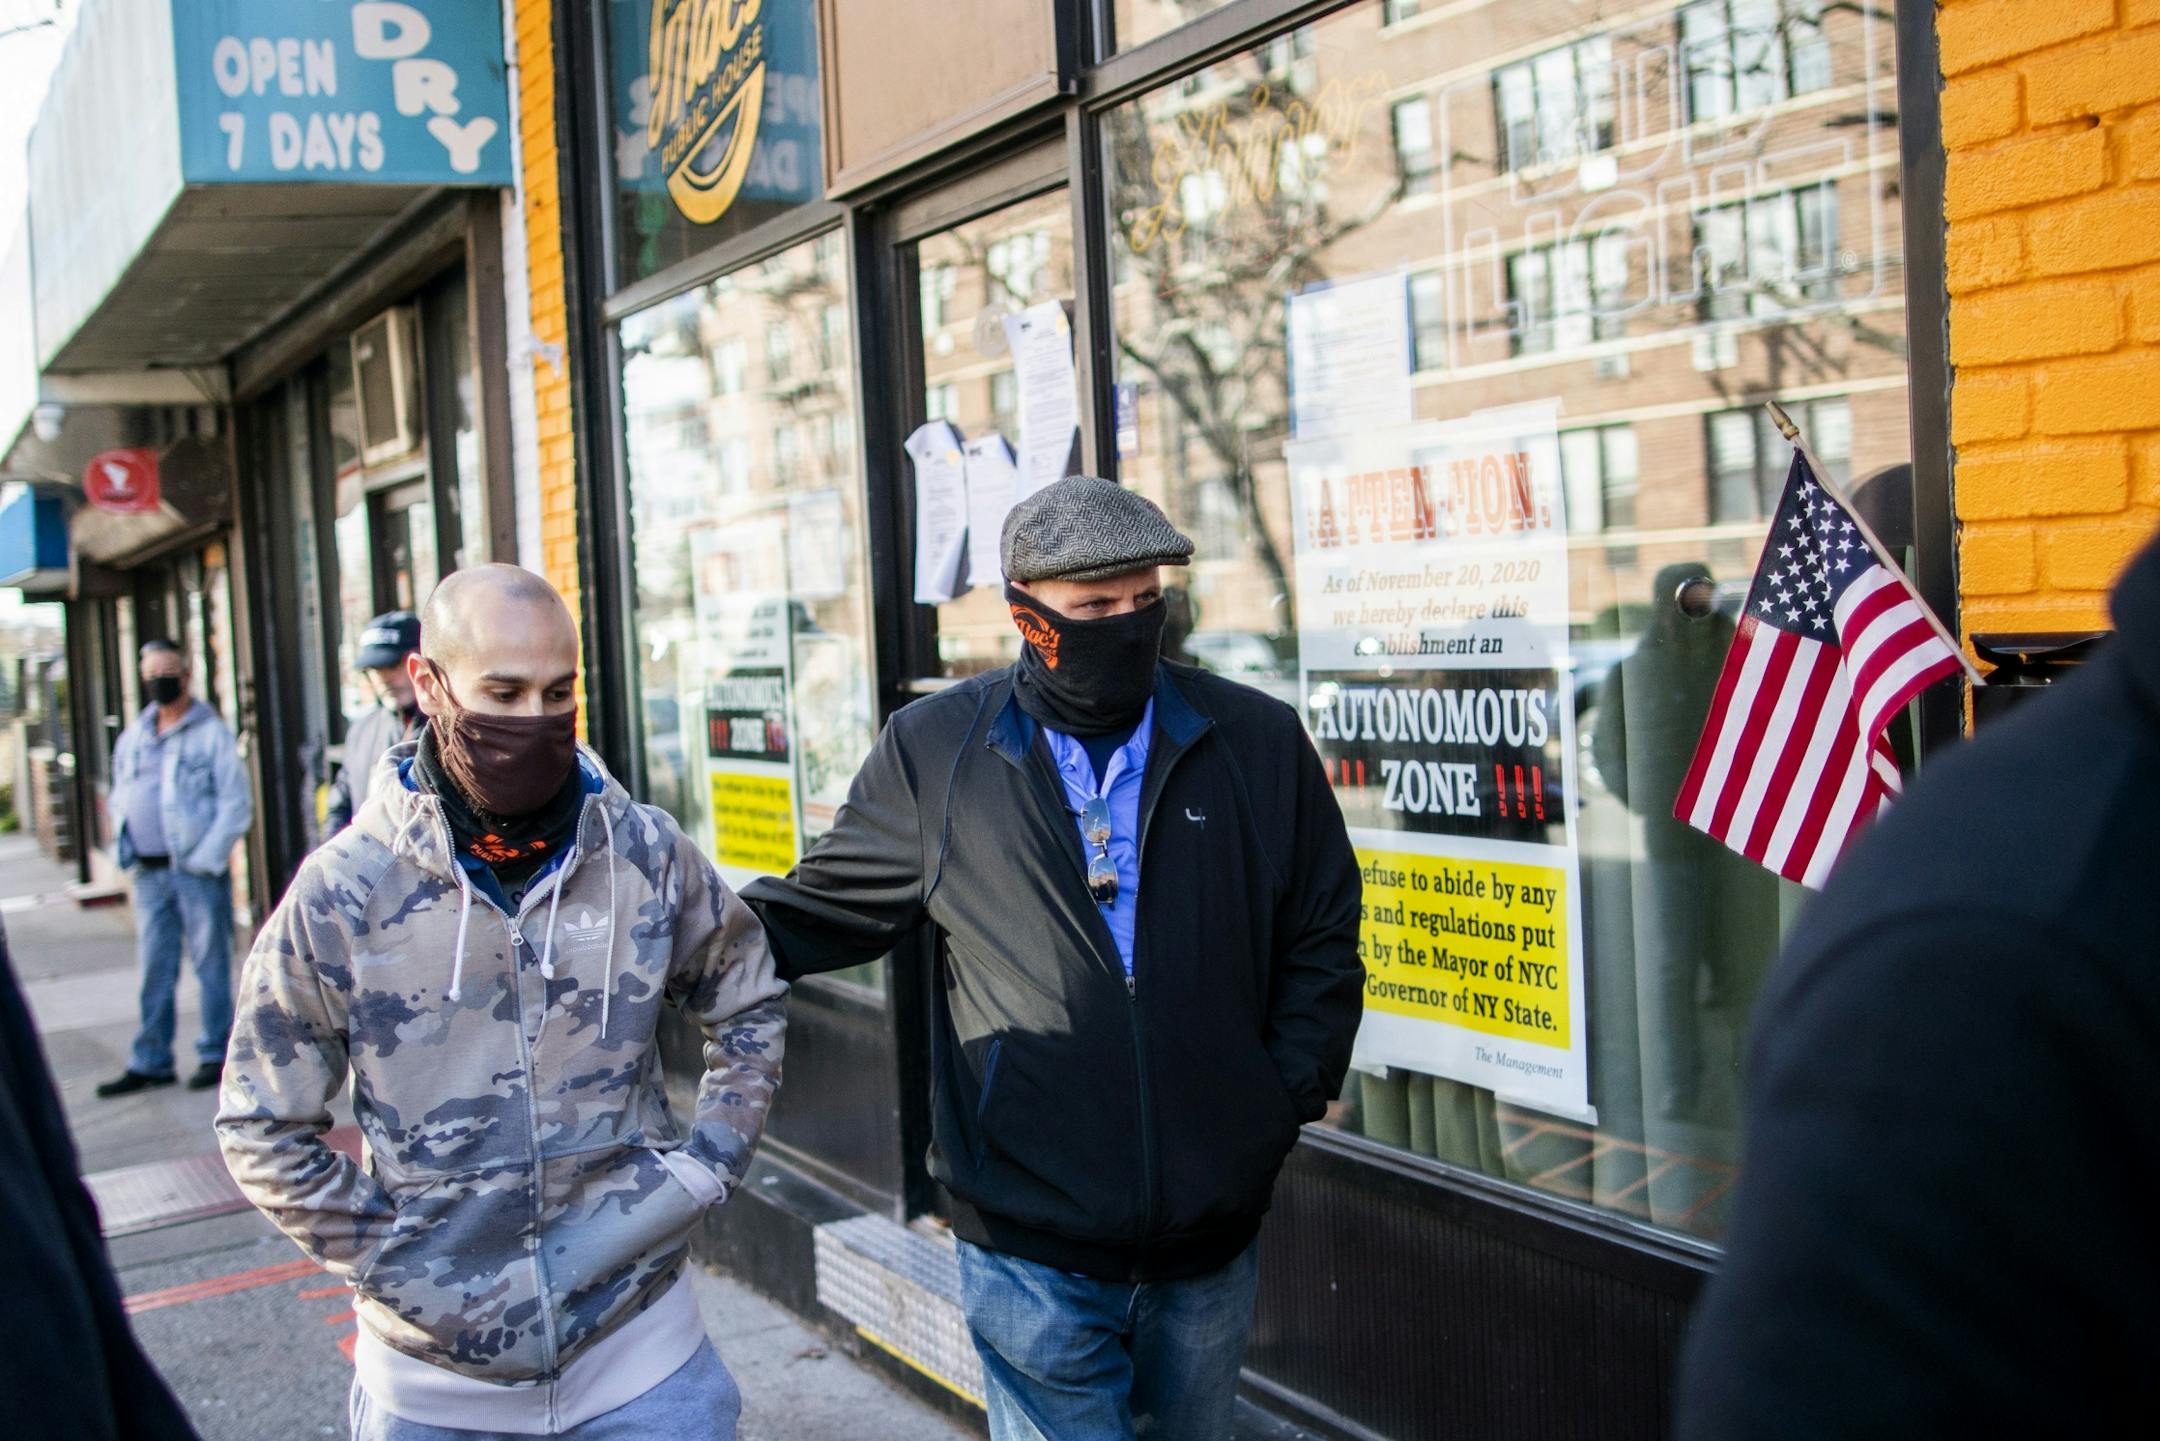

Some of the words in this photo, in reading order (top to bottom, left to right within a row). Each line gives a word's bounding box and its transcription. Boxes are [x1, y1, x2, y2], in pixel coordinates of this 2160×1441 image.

[212, 35, 337, 98] OPEN
[661, 96, 709, 174] PUBLIC
[711, 23, 763, 111] HOUSE
[218, 111, 246, 172] 7
[268, 110, 384, 172] DAYS
[1322, 574, 1341, 595] As
[1346, 569, 1365, 593] of
[1366, 564, 1453, 593] November
[1490, 559, 1542, 584] 2020
[1333, 609, 1354, 626] we
[1359, 599, 1417, 629] hereby
[1420, 597, 1486, 622] declare
[1491, 594, 1530, 619] this
[1353, 632, 1477, 657] eablishment
[1479, 637, 1504, 655] an
[1315, 687, 1549, 748] AUTONOMOUS
[1380, 759, 1481, 817] ZONE
[1411, 868, 1429, 892] to
[1433, 867, 1486, 898] abide
[1491, 872, 1515, 908] by
[1520, 885, 1558, 914] any
[1374, 900, 1406, 926] and
[1410, 907, 1516, 941] regulations
[1522, 924, 1556, 951] put
[1372, 934, 1392, 967] by
[1397, 938, 1427, 966] the
[1432, 946, 1489, 981] Mayor
[1494, 954, 1514, 982] of
[1518, 961, 1558, 990] NYC
[1367, 973, 1449, 1008] Governor
[1453, 987, 1470, 1014] of
[1473, 992, 1499, 1019] NY
[1504, 998, 1558, 1031] State.
[1474, 1046, 1493, 1064] The
[1495, 1053, 1564, 1078] Management
